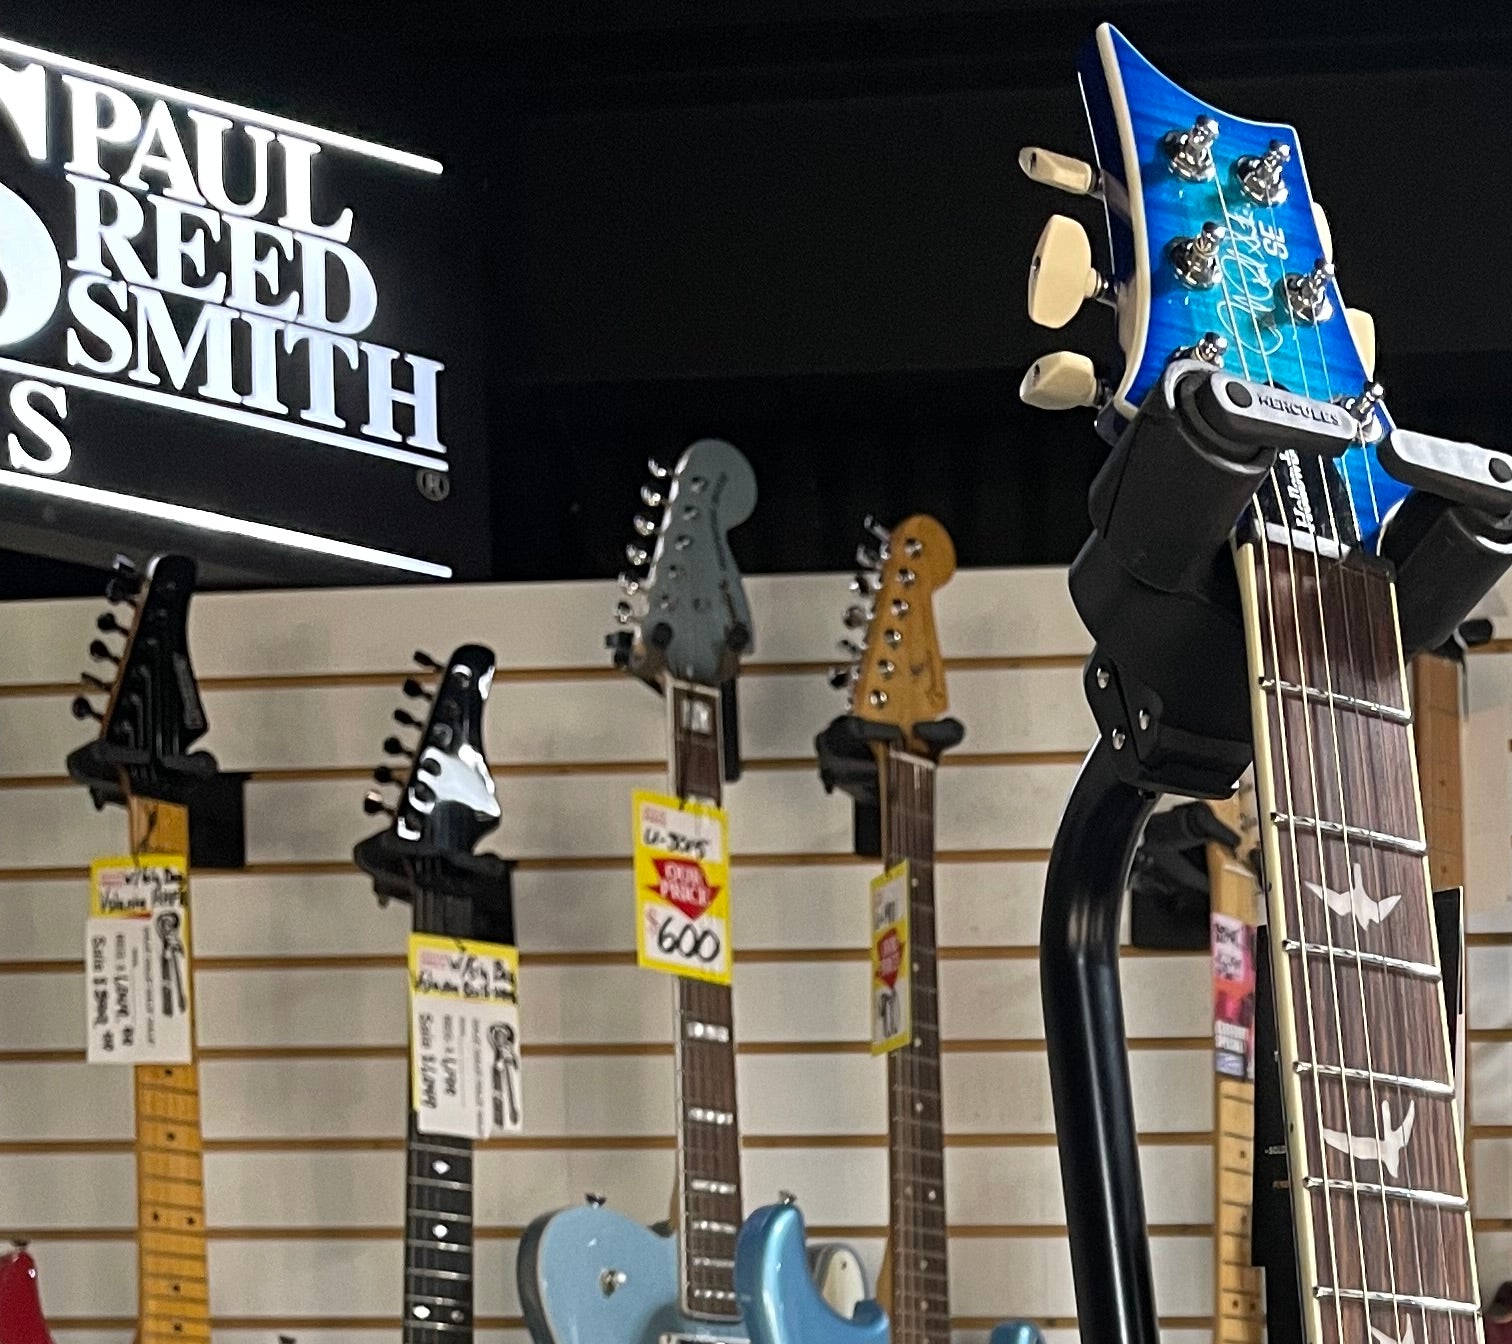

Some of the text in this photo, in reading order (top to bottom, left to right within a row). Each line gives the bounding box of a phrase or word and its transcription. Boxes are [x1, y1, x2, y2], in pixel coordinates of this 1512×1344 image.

[62, 73, 354, 244] PAUL
[1258, 220, 1289, 260] SE
[65, 172, 378, 335] REED
[66, 273, 447, 454] SMITH
[1257, 393, 1342, 426] HERCULES
